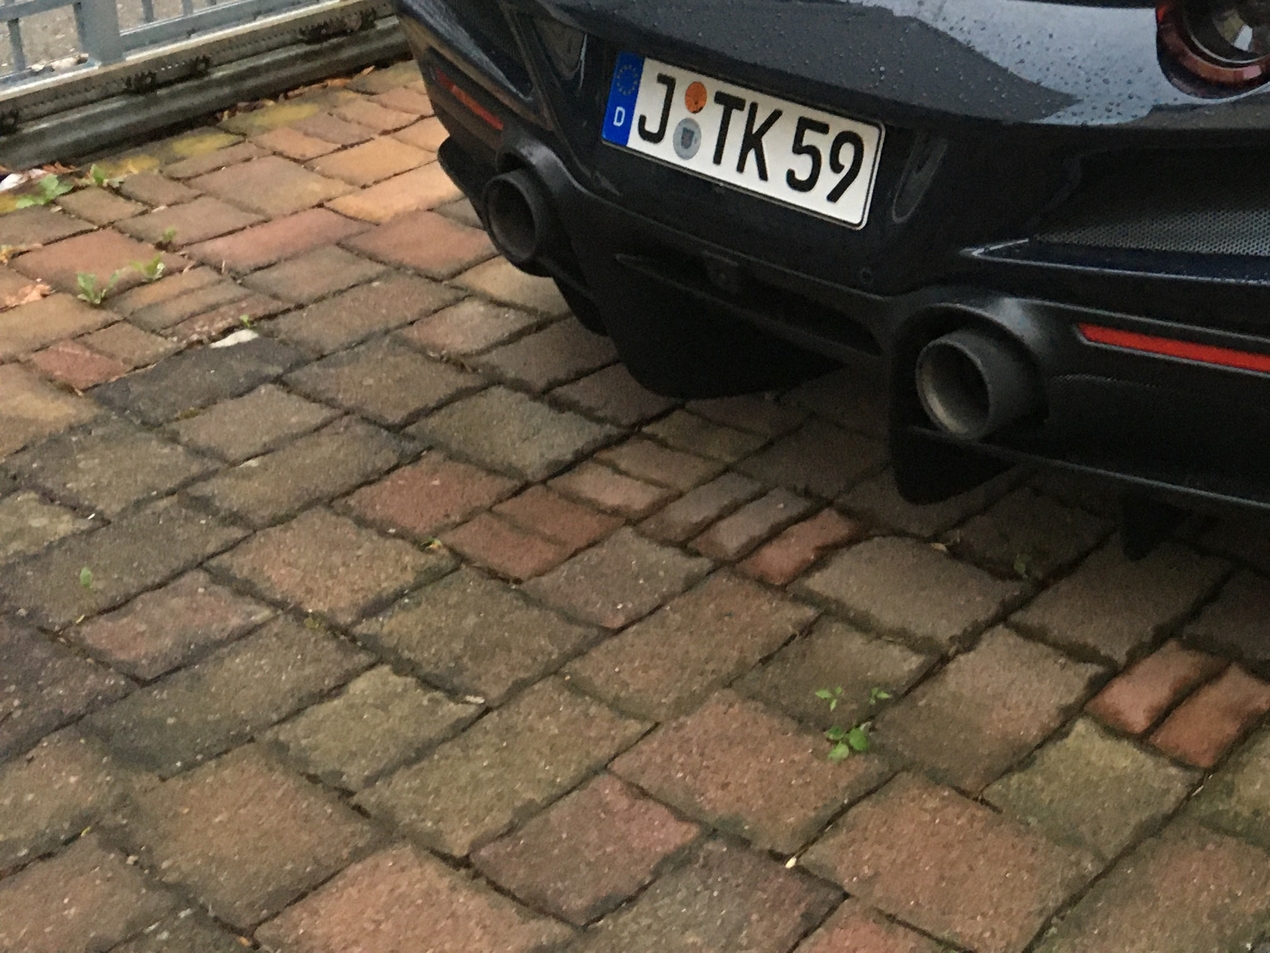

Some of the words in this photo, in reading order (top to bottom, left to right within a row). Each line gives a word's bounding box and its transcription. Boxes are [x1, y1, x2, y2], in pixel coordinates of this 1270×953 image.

[613, 106, 626, 128] D
[637, 72, 677, 145] J
[713, 91, 783, 182] TK
[786, 116, 865, 203] 59
